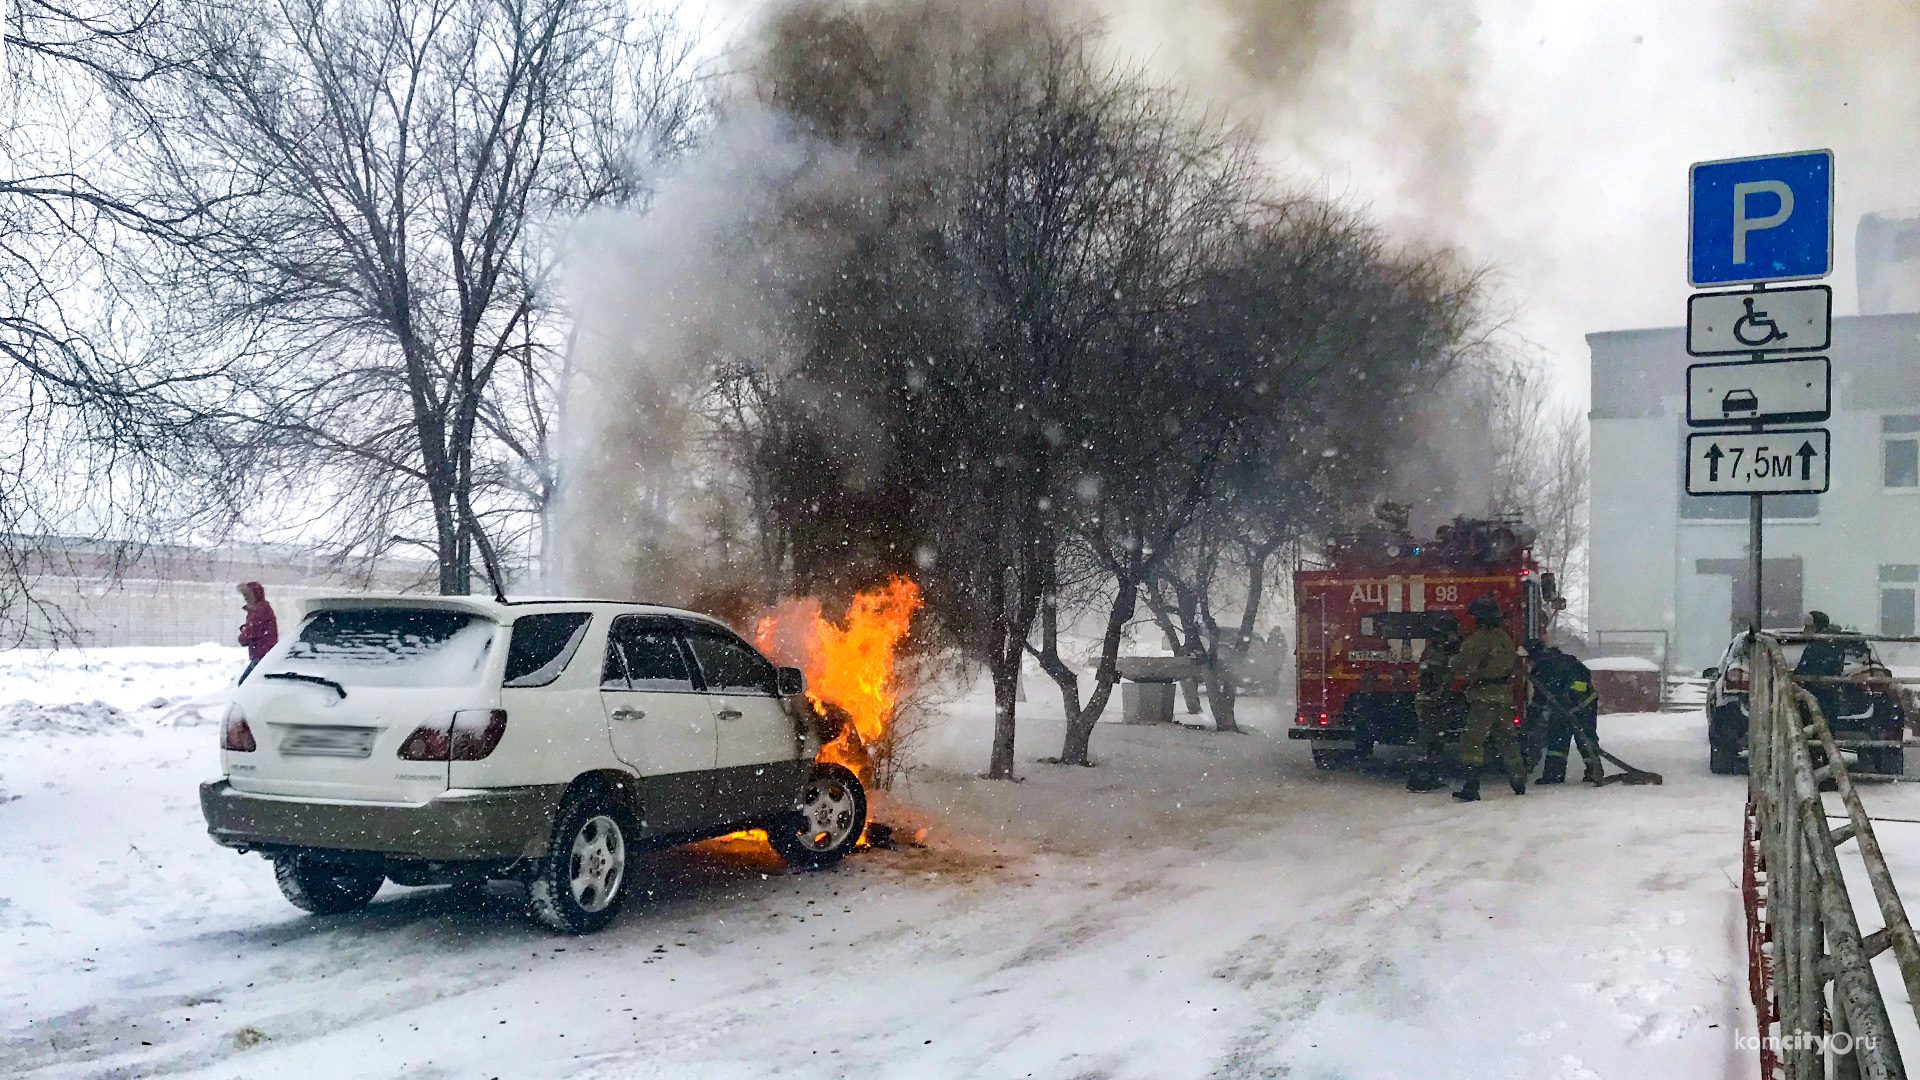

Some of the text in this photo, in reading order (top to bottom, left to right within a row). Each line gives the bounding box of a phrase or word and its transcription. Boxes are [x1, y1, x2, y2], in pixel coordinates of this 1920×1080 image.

[1733, 180, 1794, 264] P
[1349, 584, 1458, 606] АЦ 98
